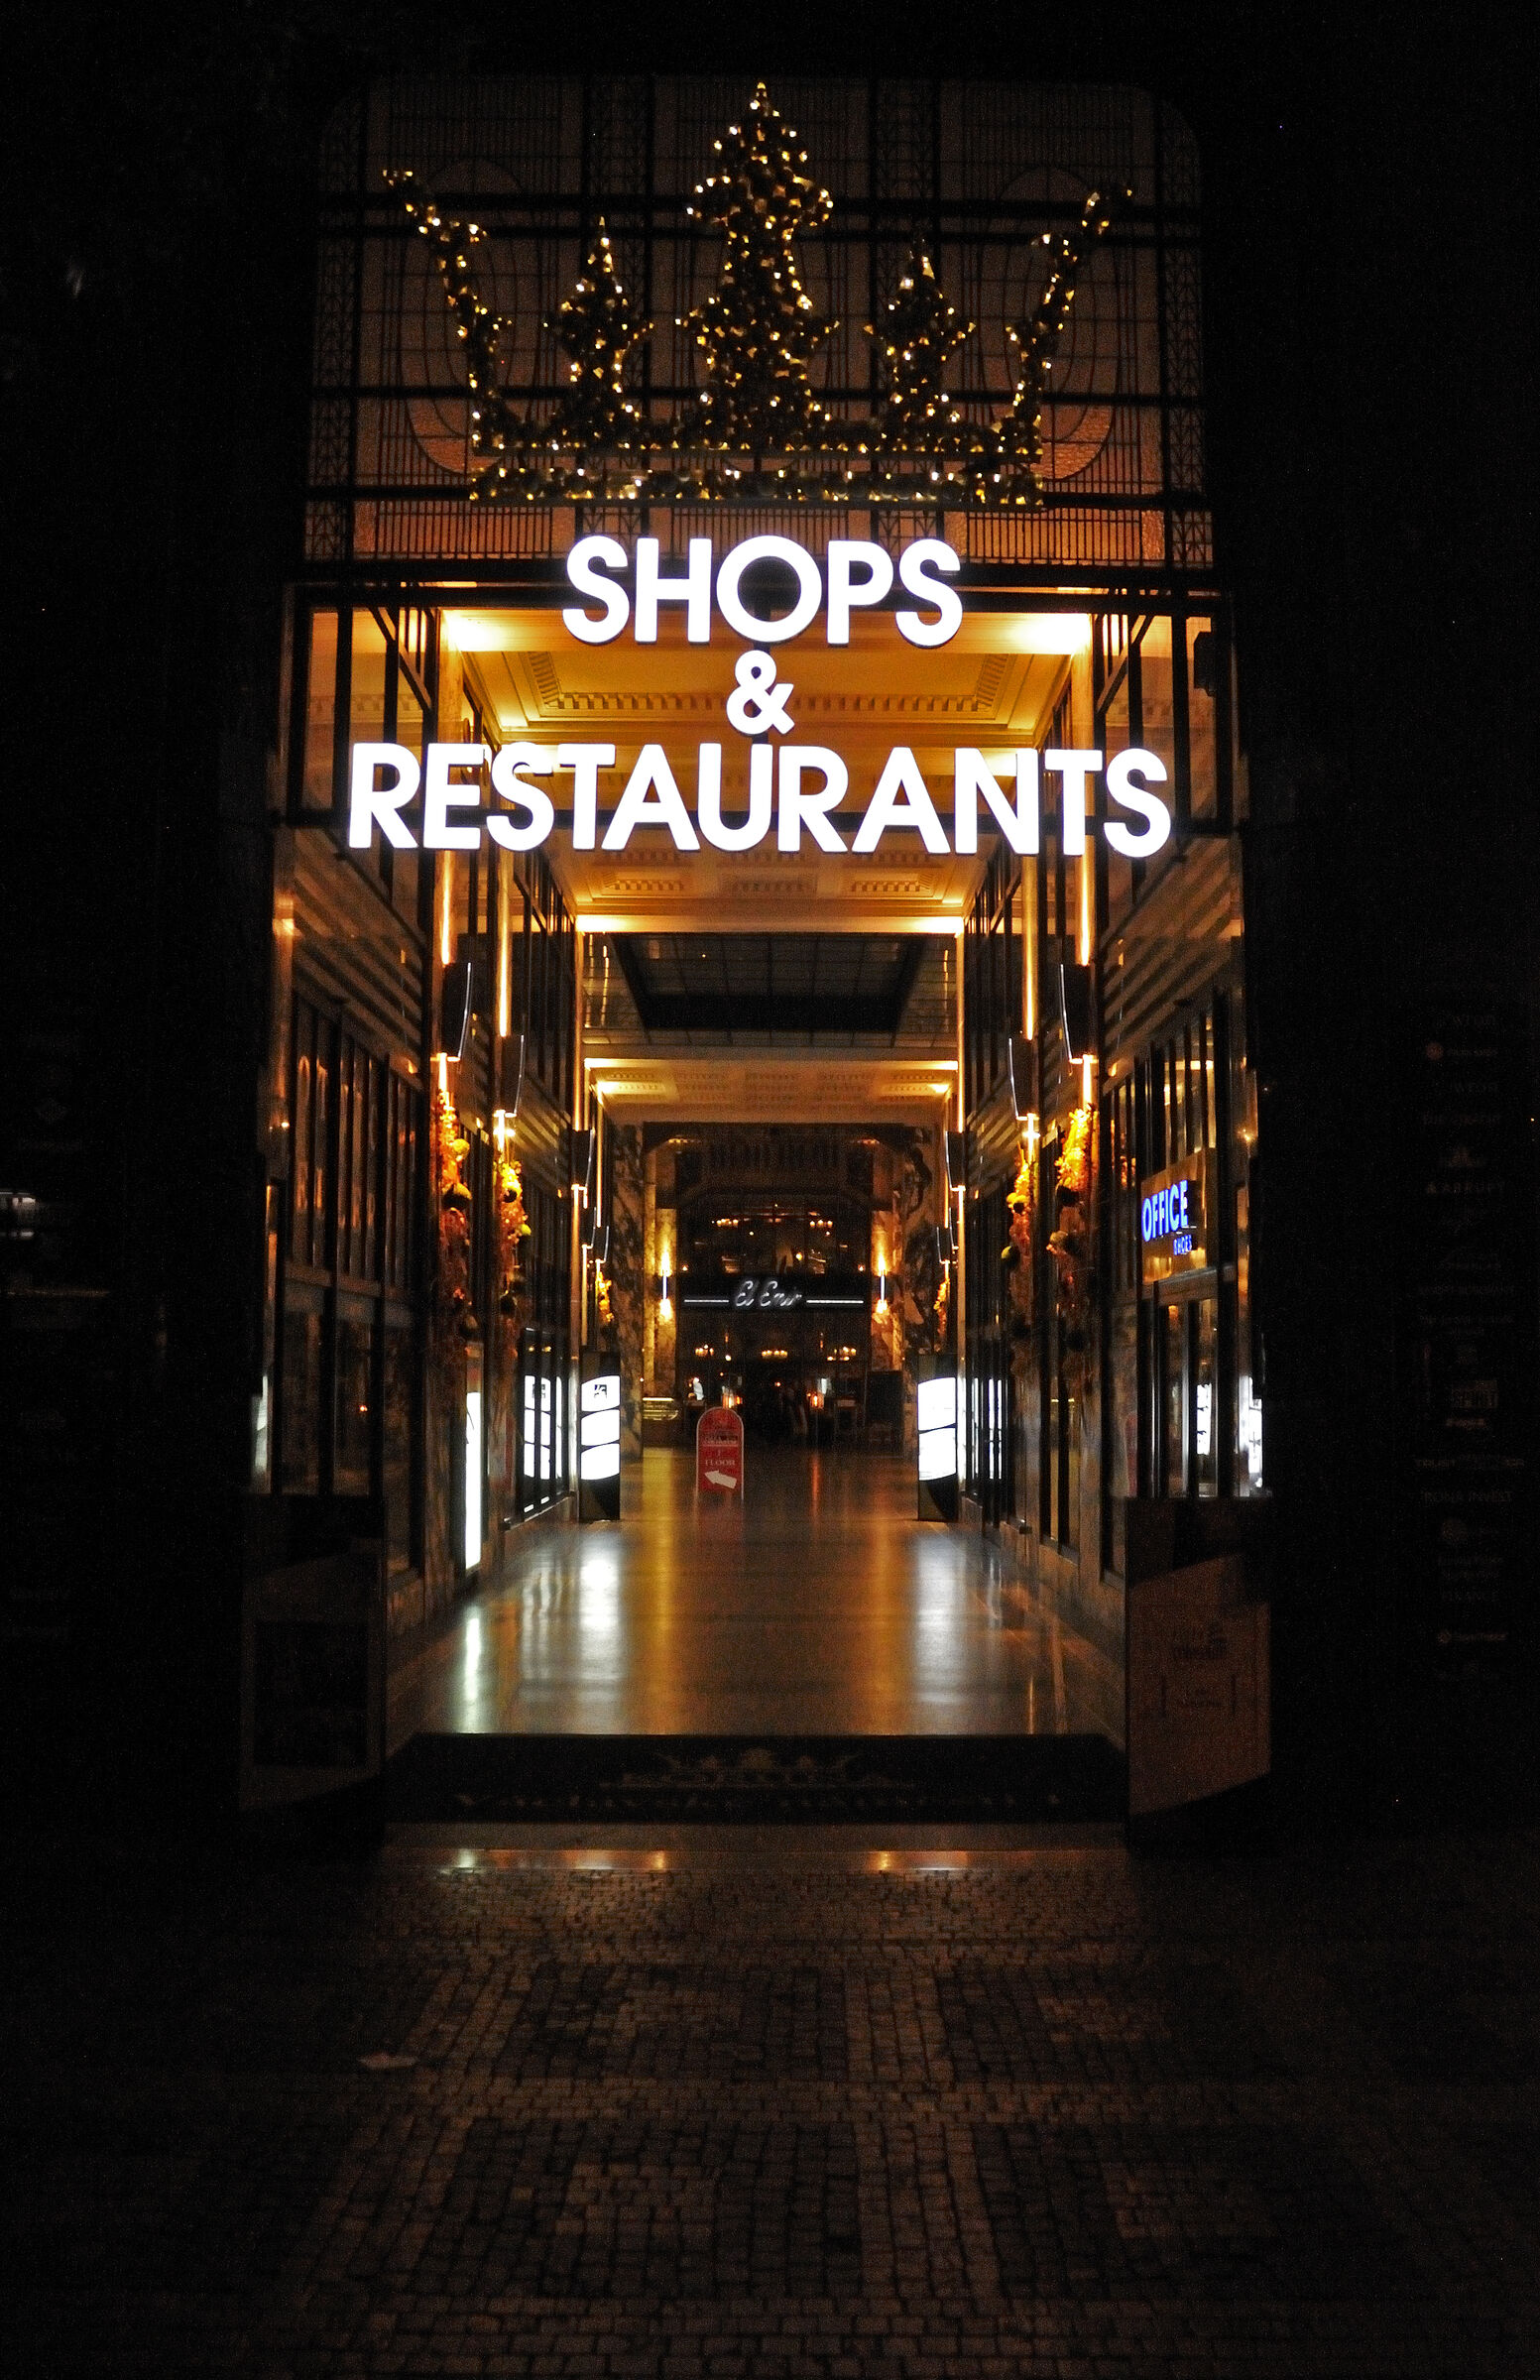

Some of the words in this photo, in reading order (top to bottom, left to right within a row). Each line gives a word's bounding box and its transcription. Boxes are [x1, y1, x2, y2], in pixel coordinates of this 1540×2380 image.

[561, 535, 964, 648] SHOPS
[726, 650, 795, 736] &
[348, 741, 1172, 859] RESTAURANTS
[1141, 1179, 1189, 1243] OFFICE
